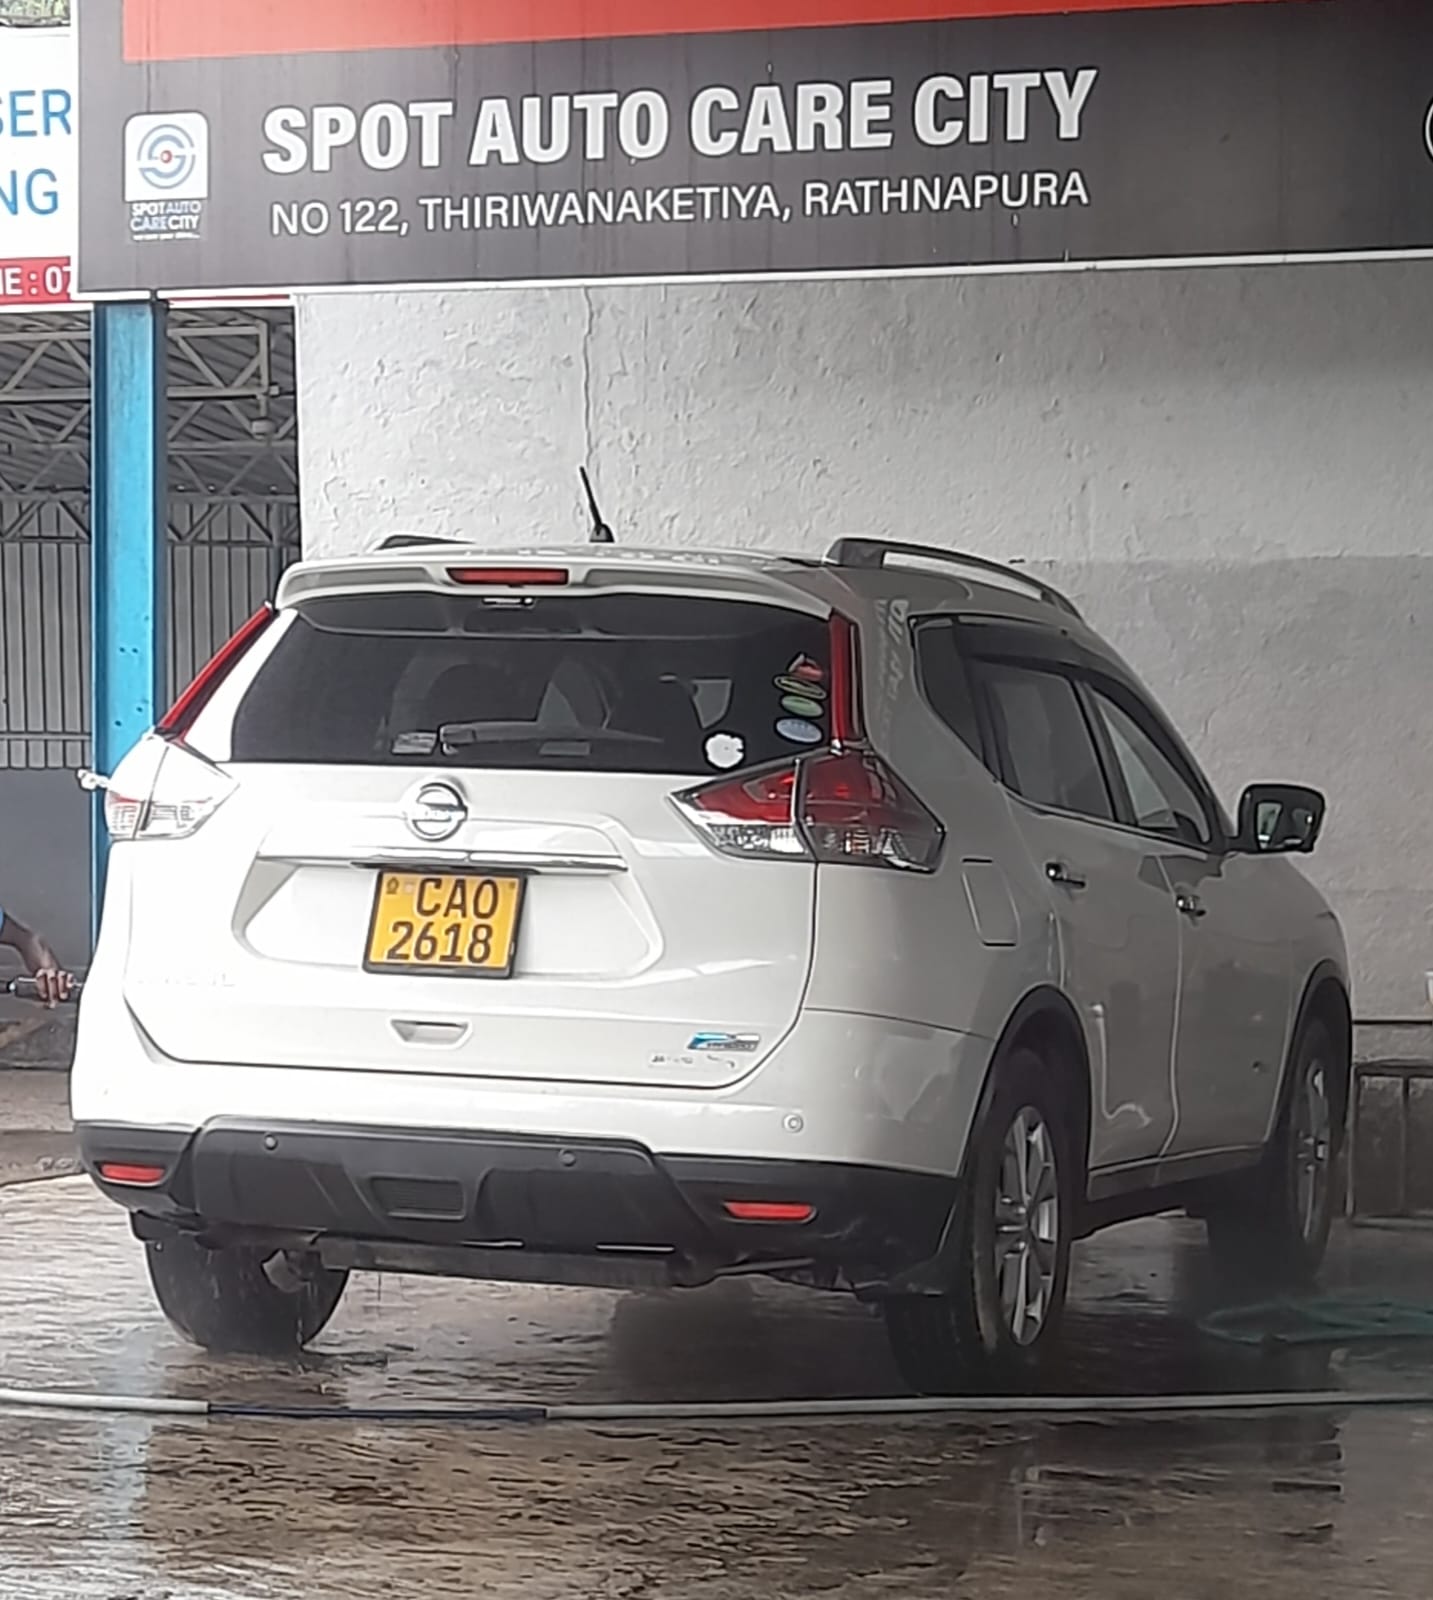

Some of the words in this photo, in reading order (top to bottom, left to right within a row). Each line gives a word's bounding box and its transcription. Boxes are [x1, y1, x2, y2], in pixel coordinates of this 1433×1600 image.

[0, 89, 72, 137] ER
[262, 102, 454, 174] SPOT
[469, 90, 669, 165] AUTO
[691, 79, 892, 156] CARE
[914, 69, 1098, 146] CITY
[271, 201, 328, 236] NO
[338, 198, 409, 236] 122,
[419, 184, 792, 230] THIRIWANAKETIYA,
[804, 171, 1090, 216] RATHNAPURA
[0, 267, 22, 295] E
[387, 921, 493, 963] 2618
